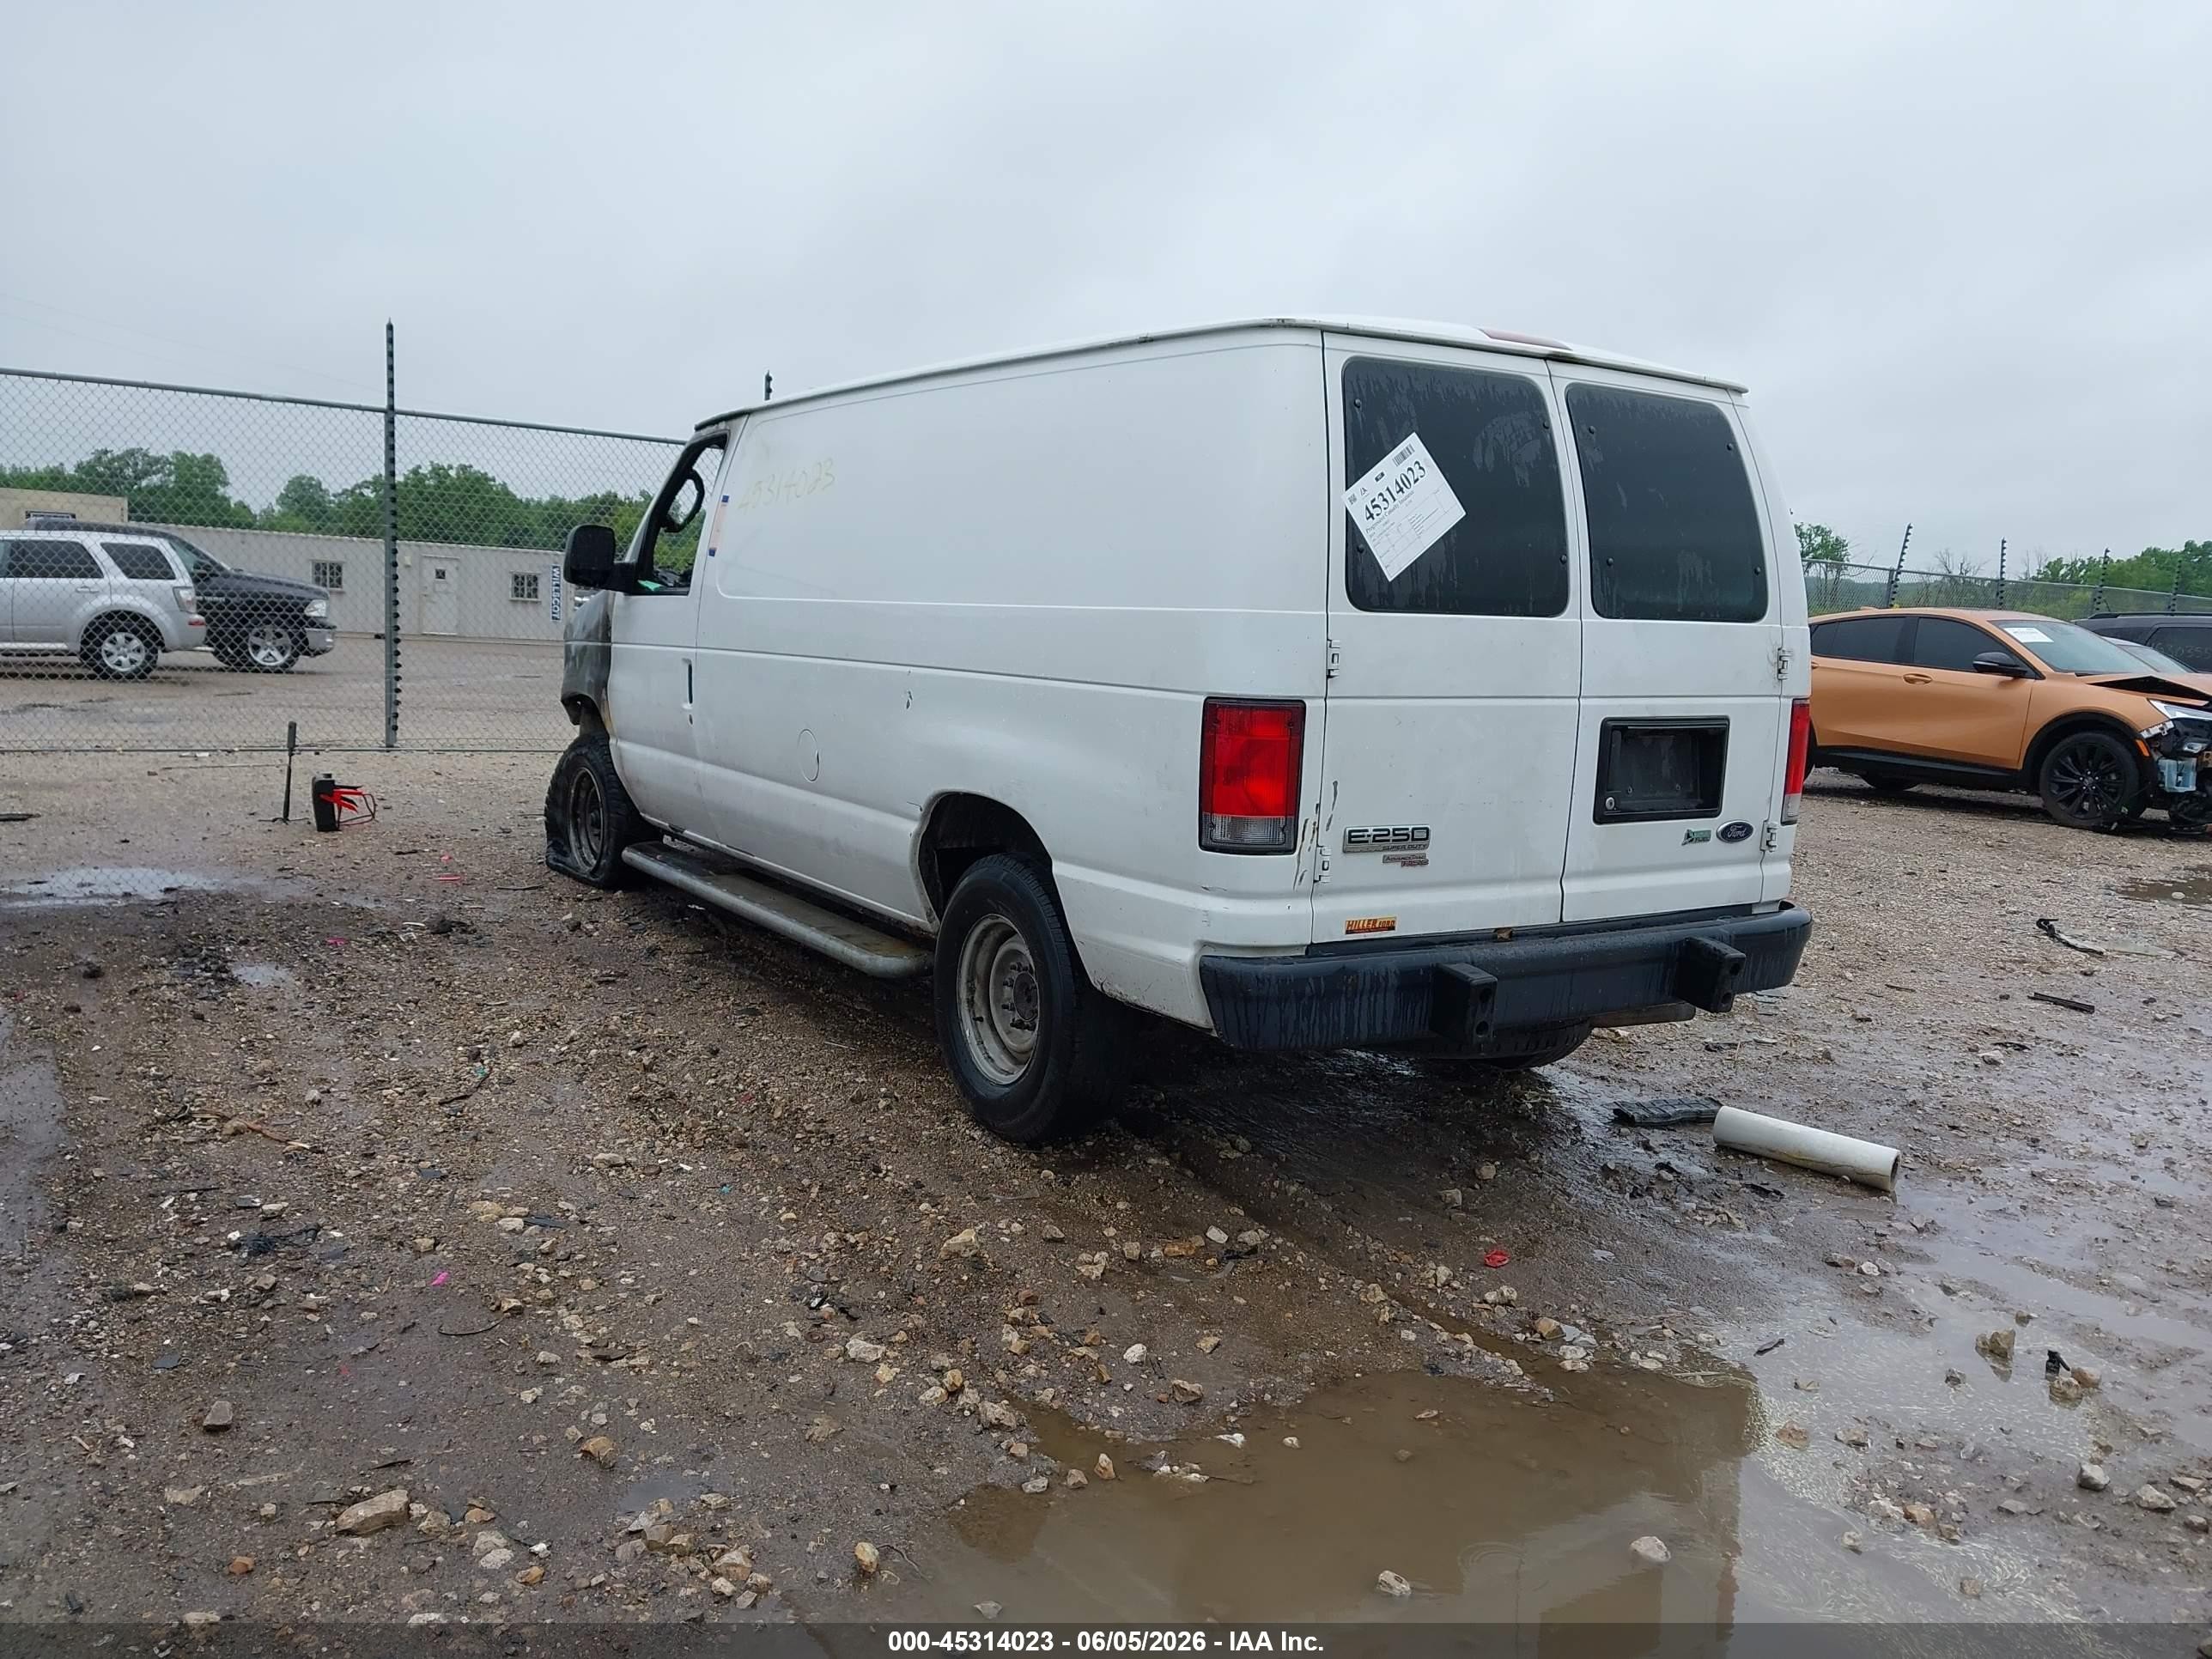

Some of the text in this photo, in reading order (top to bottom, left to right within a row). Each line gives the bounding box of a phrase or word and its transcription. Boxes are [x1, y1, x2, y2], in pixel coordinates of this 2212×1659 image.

[1364, 460, 1426, 521] 45314023
[1347, 827, 1430, 844] E-250
[1727, 824, 1747, 838] Ford
